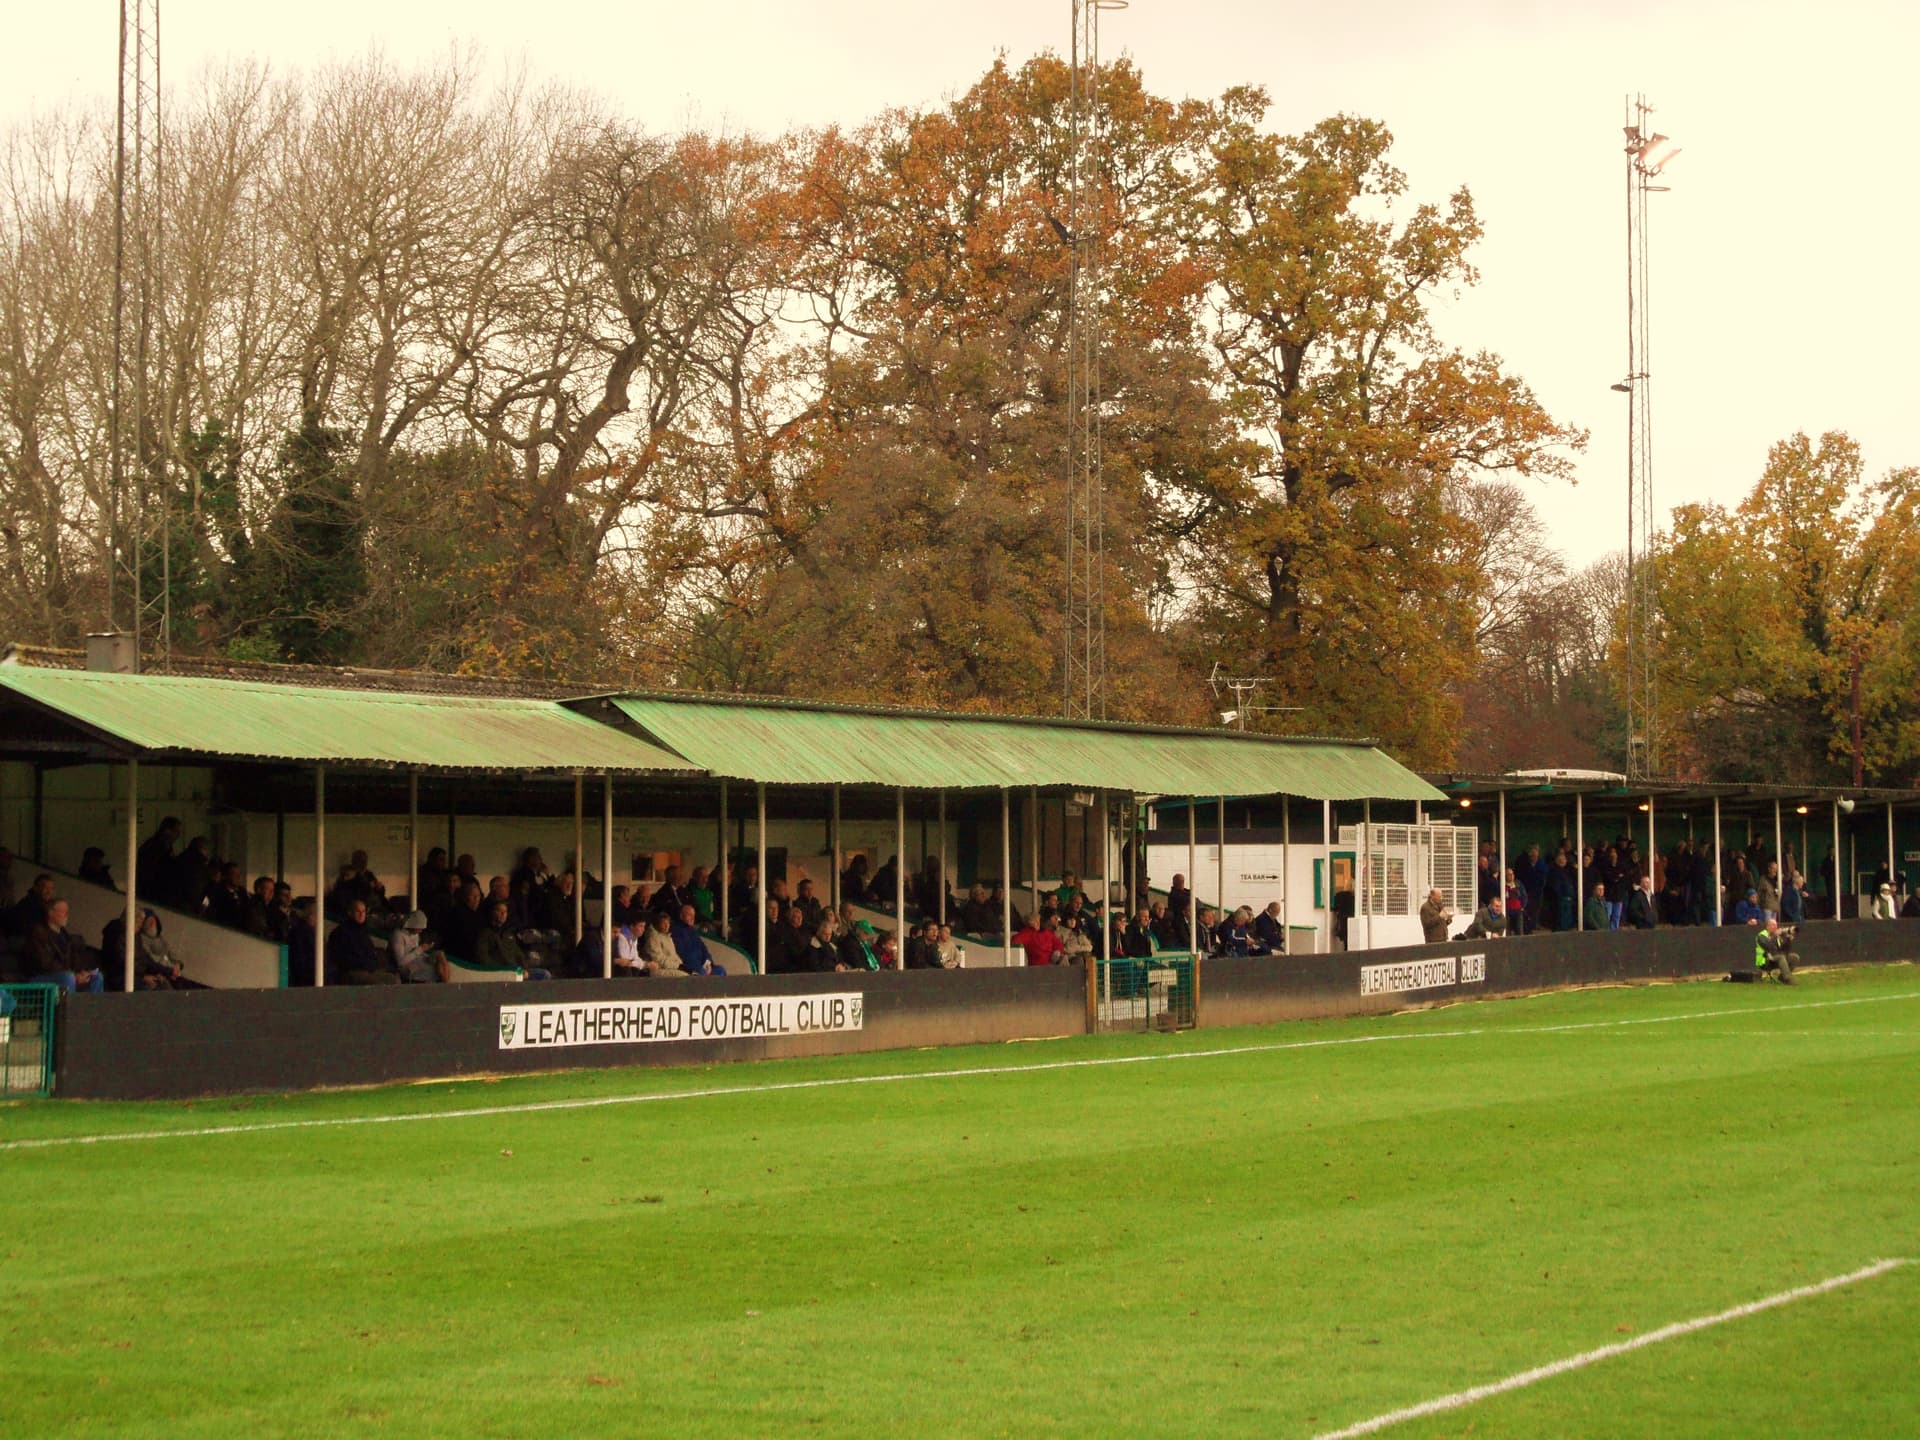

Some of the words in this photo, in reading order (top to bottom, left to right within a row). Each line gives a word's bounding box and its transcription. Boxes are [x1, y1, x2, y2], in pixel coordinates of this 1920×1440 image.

[1368, 965, 1422, 992] LEATHERHEAD
[1461, 958, 1479, 981] CLUB
[524, 1006, 681, 1044] LEATHERHEAD
[689, 1001, 790, 1037] FOOTBALL
[797, 998, 845, 1030] CLUB
